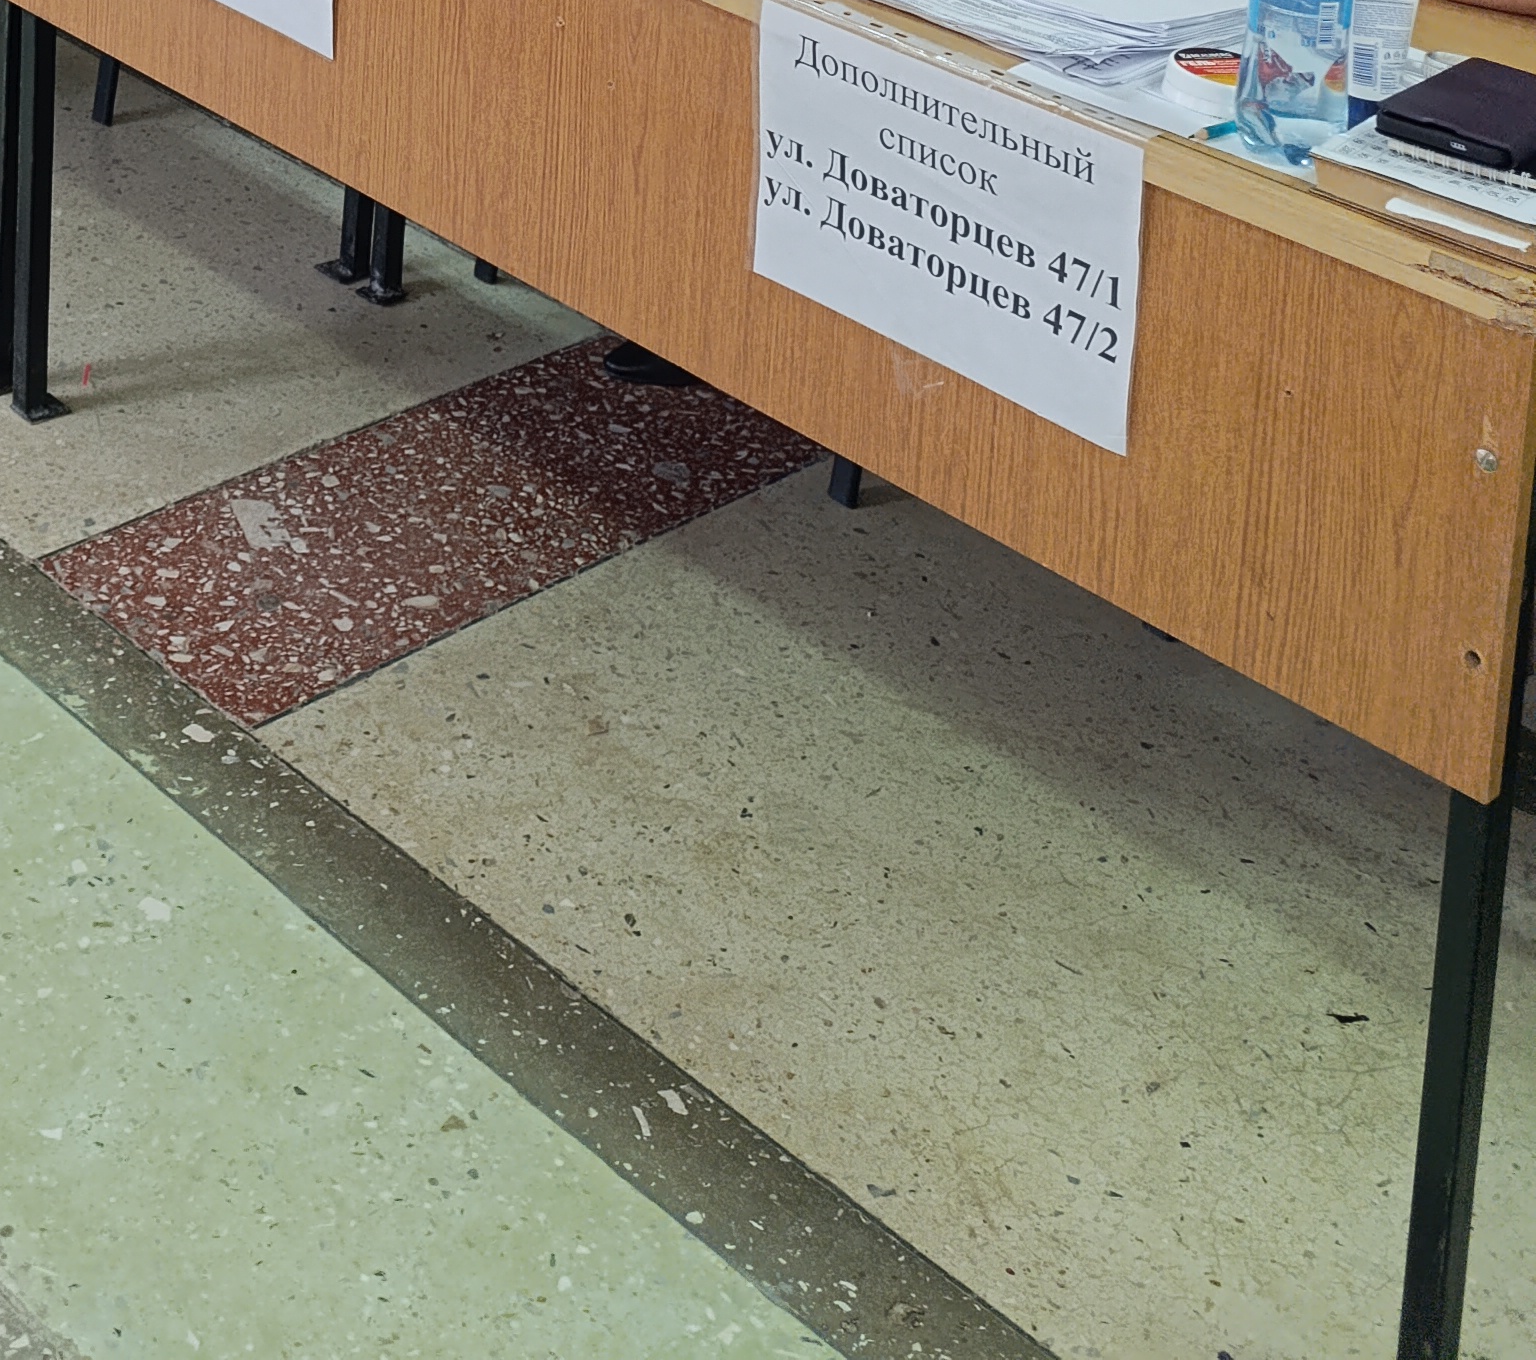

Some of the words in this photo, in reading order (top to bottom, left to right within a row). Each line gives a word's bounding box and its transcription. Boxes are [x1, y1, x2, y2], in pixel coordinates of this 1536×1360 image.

[794, 33, 1096, 185] Дополнительный
[878, 126, 999, 197] список
[763, 175, 811, 217] ул.
[820, 195, 1031, 321] Доваторцев
[1042, 303, 1118, 364] 47/2
[765, 128, 813, 169] ул.
[822, 147, 1036, 269] Доваторцев
[1047, 251, 1123, 311] 47/1
